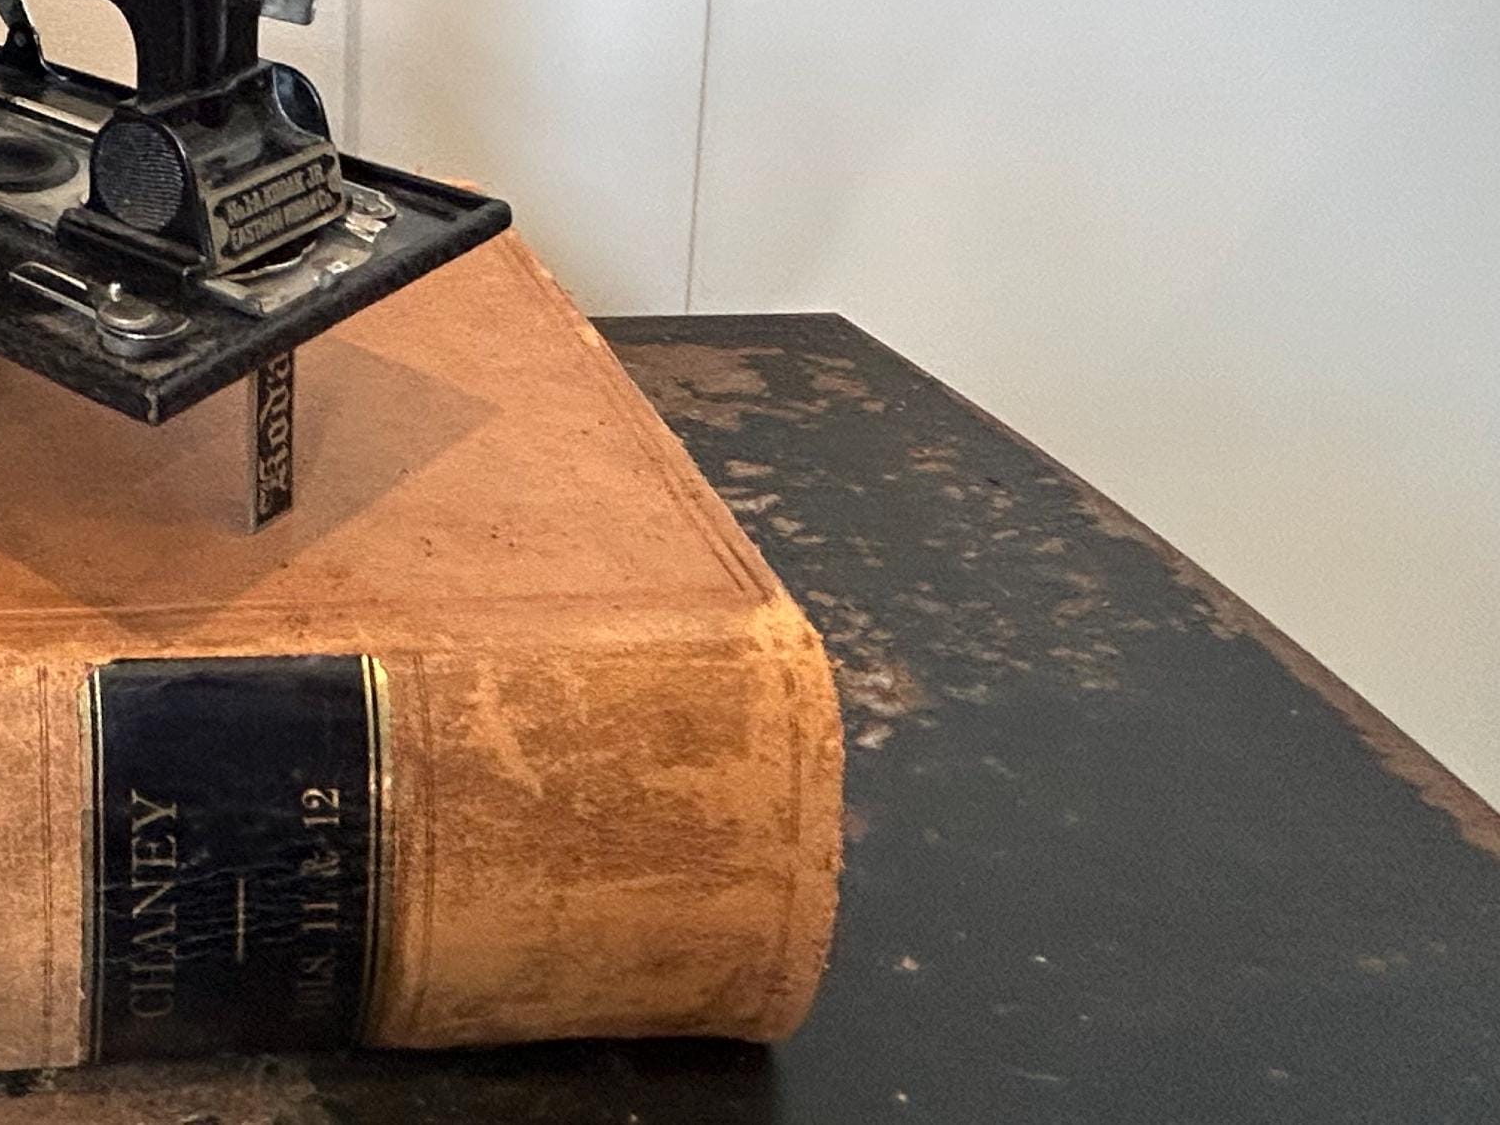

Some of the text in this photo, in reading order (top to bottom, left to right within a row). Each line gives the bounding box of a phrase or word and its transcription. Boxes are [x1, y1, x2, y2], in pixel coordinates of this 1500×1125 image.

[258, 352, 290, 513] Koda
[299, 787, 341, 829] 12
[299, 850, 340, 878] &
[130, 788, 179, 1018] CHANEY
[299, 901, 340, 934] 11
